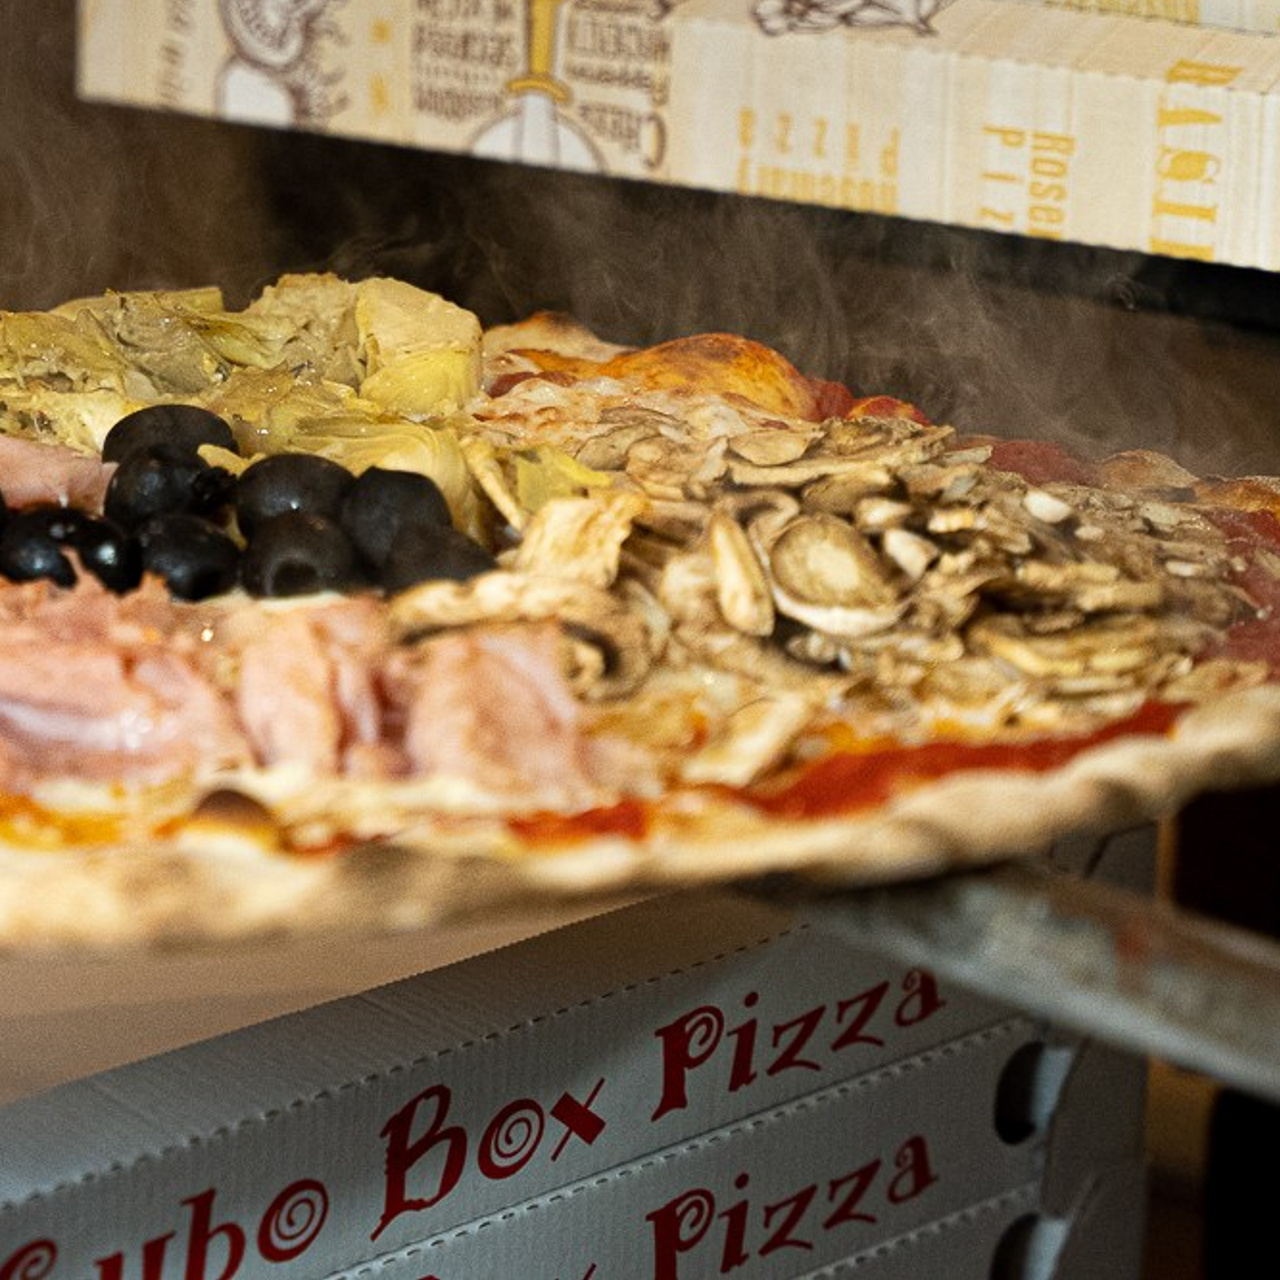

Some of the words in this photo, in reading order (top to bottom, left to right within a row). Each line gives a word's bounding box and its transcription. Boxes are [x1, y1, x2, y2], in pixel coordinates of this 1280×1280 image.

[371, 1078, 606, 1241] Box
[651, 967, 947, 1122] Pizza
[646, 1134, 940, 1280] Pizza
